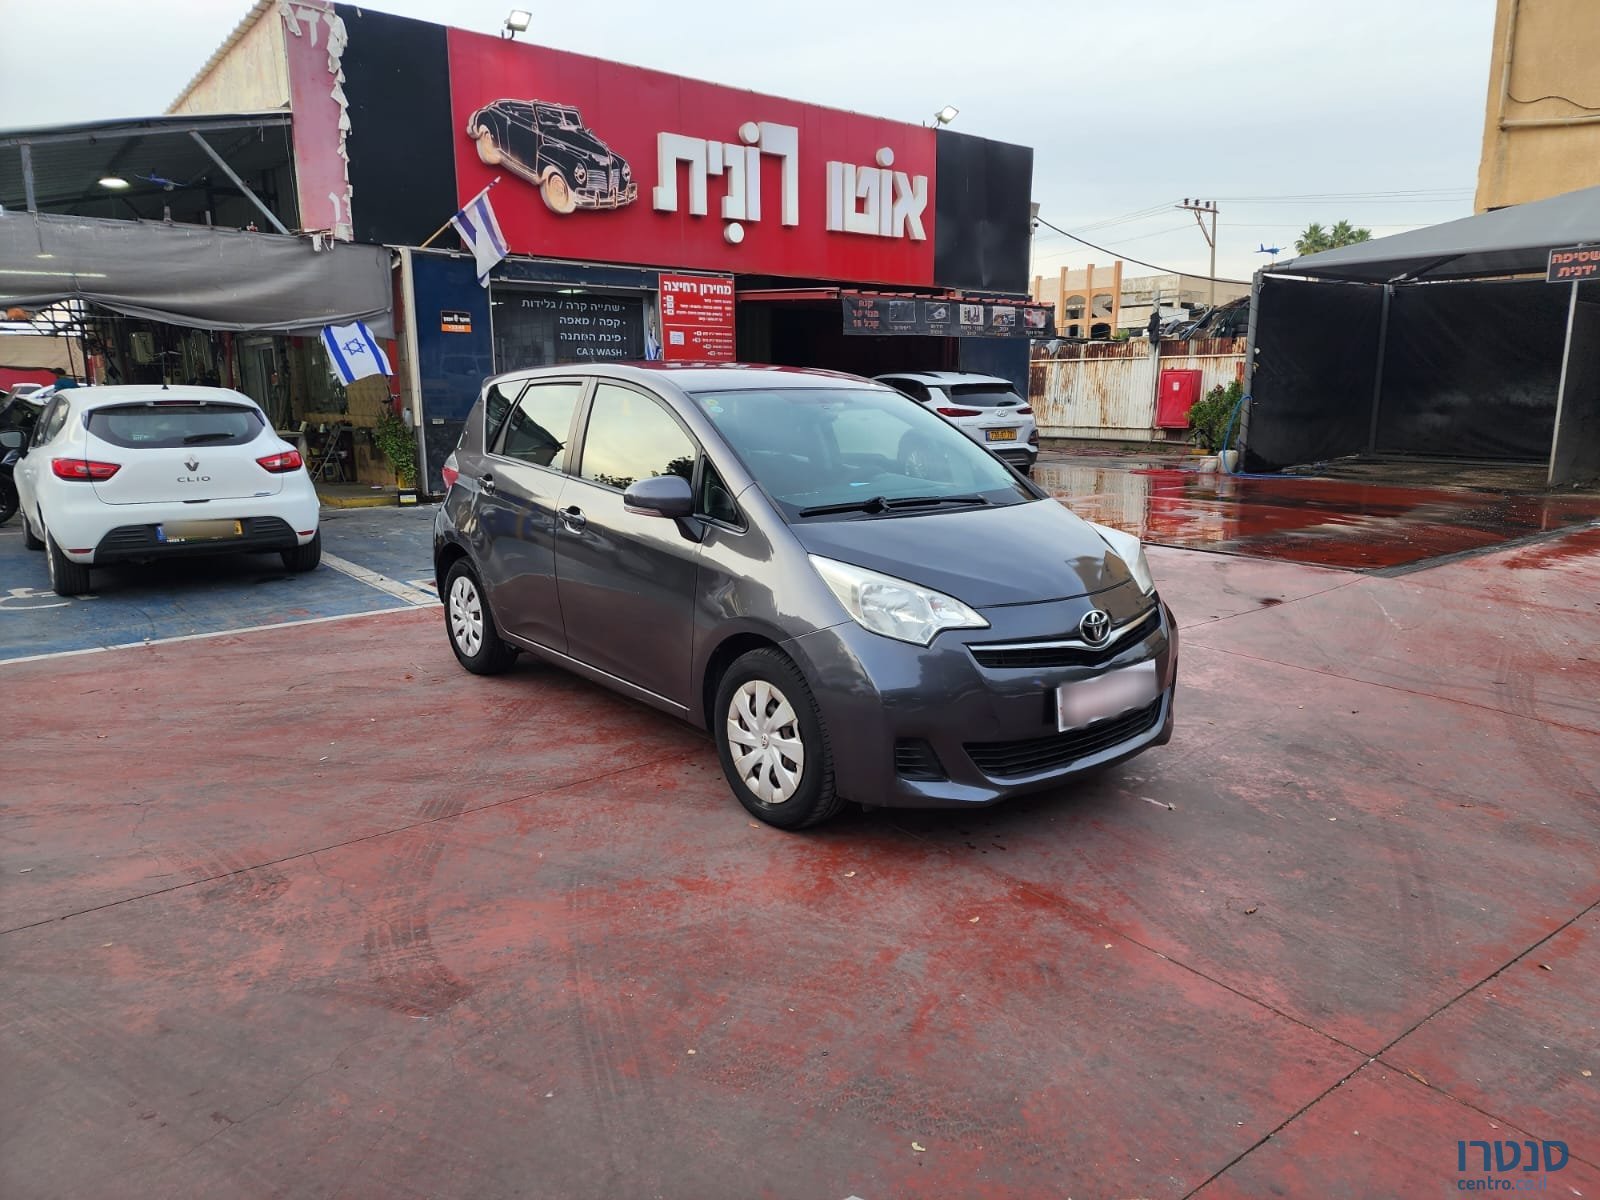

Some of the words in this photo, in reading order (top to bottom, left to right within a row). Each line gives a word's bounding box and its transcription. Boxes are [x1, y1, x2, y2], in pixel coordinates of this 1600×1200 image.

[1551, 250, 1600, 264] שטיפה
[1557, 264, 1597, 278] ידנית
[663, 280, 698, 293] רחיצה
[700, 283, 732, 297] מחירון
[521, 299, 556, 309] גלידות
[566, 302, 588, 312] קרה
[590, 303, 620, 312] שתייה
[559, 315, 590, 326] מאפה
[599, 317, 621, 329] קפה
[560, 332, 596, 342] המתנה
[598, 334, 622, 342] פינת
[576, 347, 594, 356] CAR
[596, 348, 623, 357] WASH
[176, 475, 211, 483] CLIO
